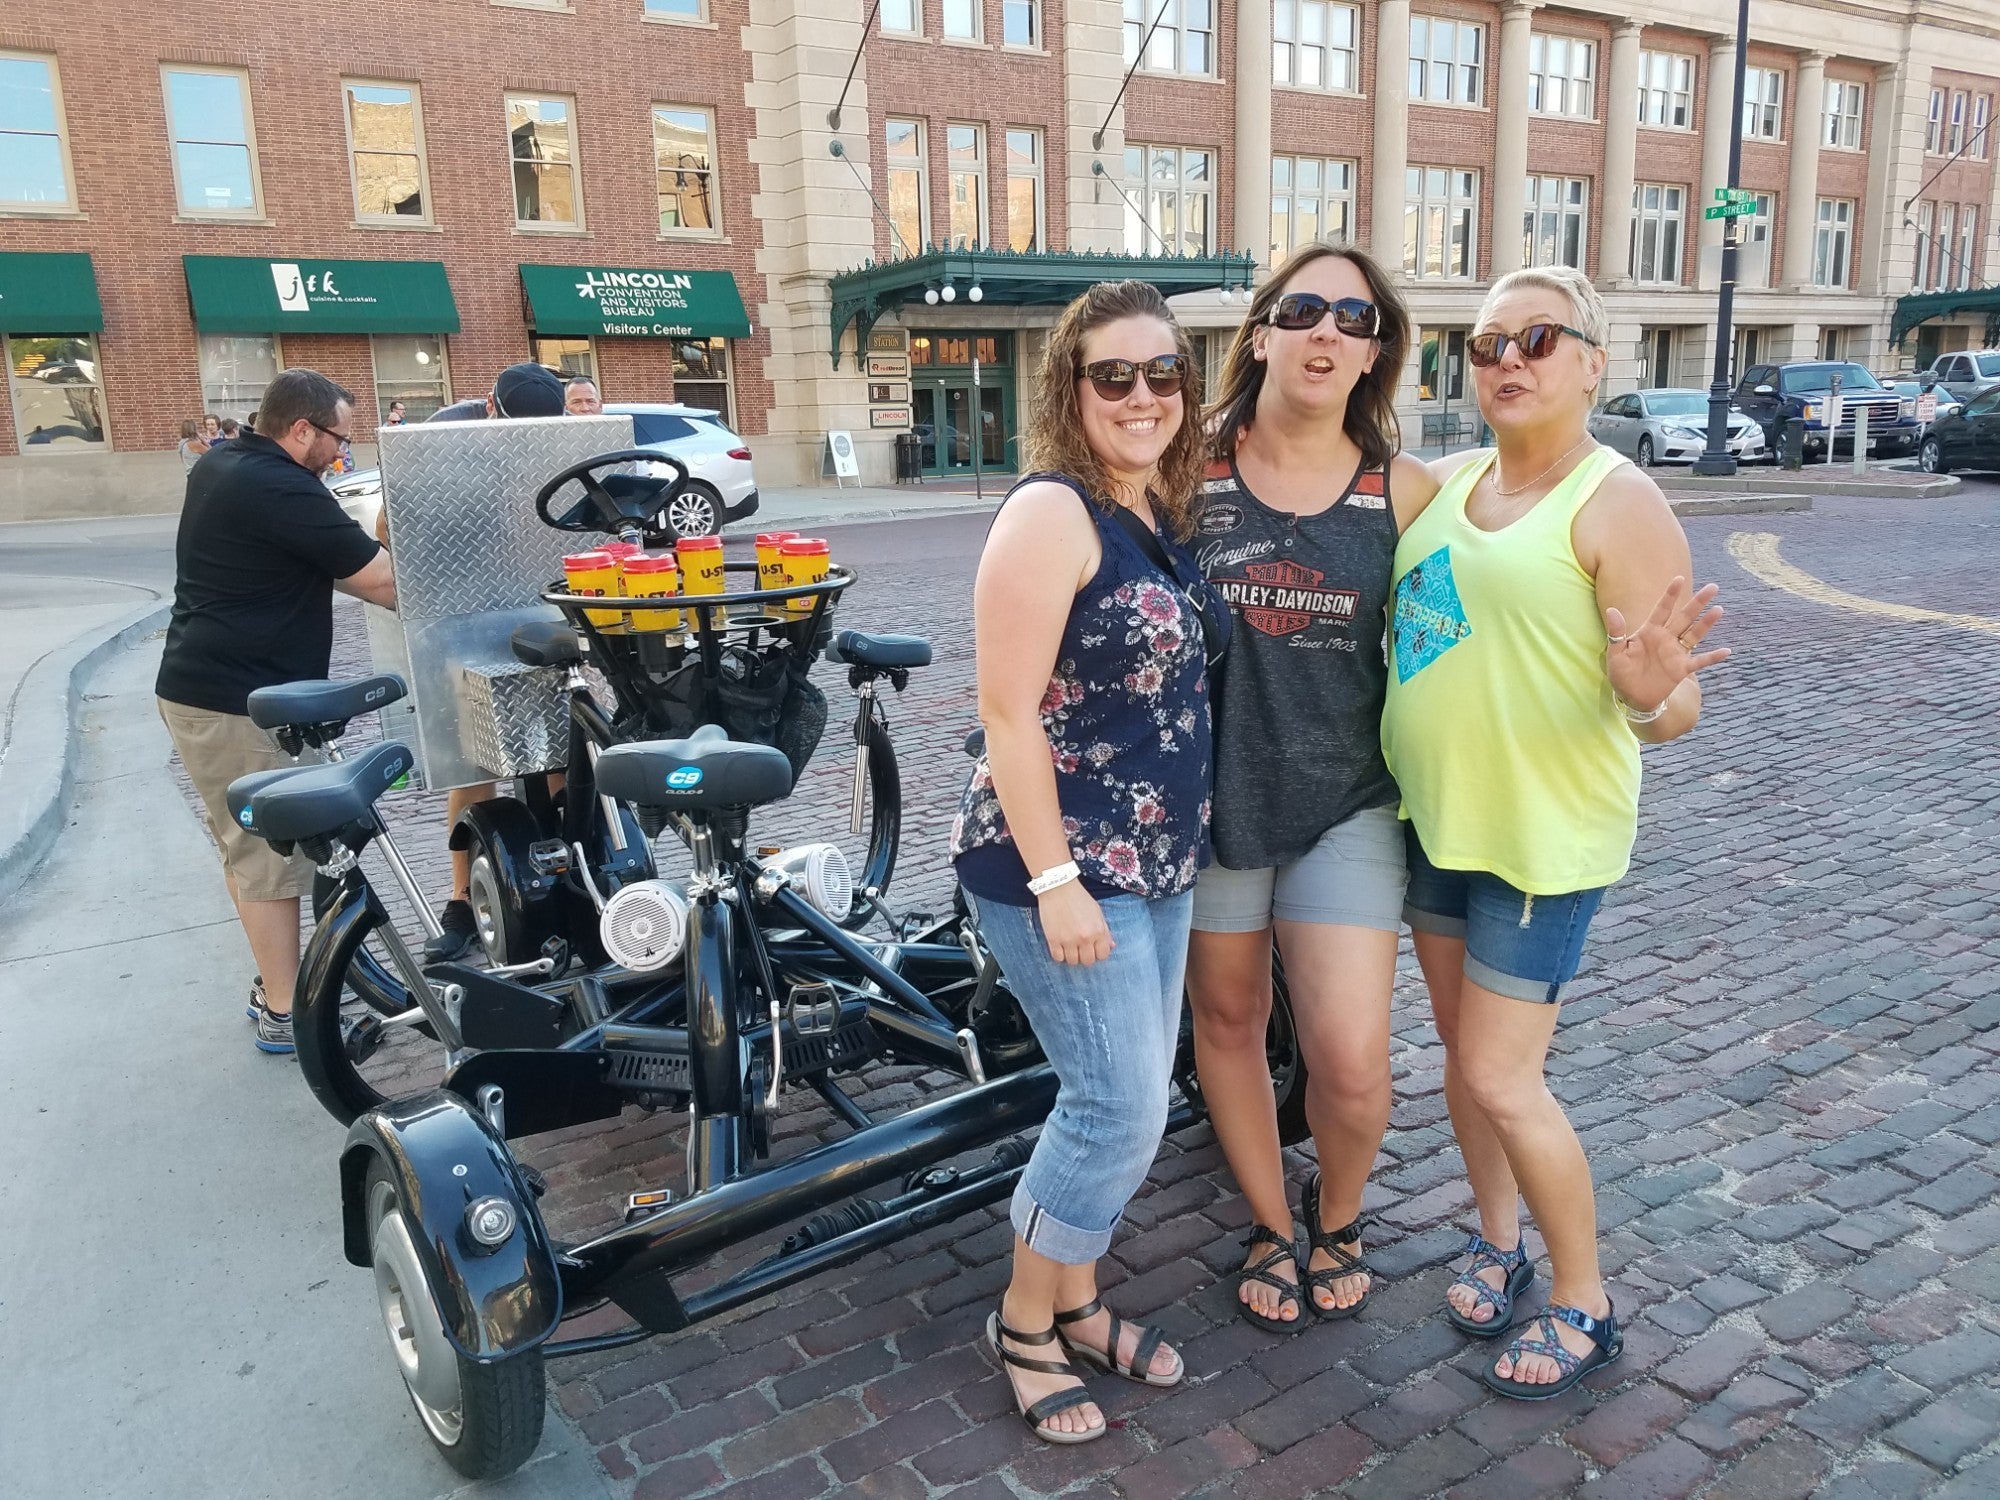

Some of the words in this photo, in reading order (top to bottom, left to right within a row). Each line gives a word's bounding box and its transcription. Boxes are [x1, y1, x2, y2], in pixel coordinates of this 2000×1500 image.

[1718, 190, 1724, 200] N
[1711, 208, 1718, 218] P
[1722, 203, 1751, 216] STREET
[586, 271, 692, 290] LINCOLN
[596, 287, 682, 299] CONVENTION
[600, 298, 628, 308] AND
[630, 298, 688, 309] VISITORS
[602, 306, 655, 317] BUREAU
[603, 322, 648, 335] Visitors
[653, 323, 693, 336] Center
[873, 336, 899, 347] STATION
[1195, 539, 1276, 579] Genuine
[1252, 562, 1316, 585] MOTOR
[1246, 611, 1306, 634] CYCLES
[1318, 617, 1350, 628] MARK
[856, 640, 869, 651] C9
[1288, 635, 1323, 649] Since
[1325, 637, 1359, 652] 1903
[365, 686, 386, 703] C9
[383, 757, 403, 780] C9
[669, 772, 700, 785] C9
